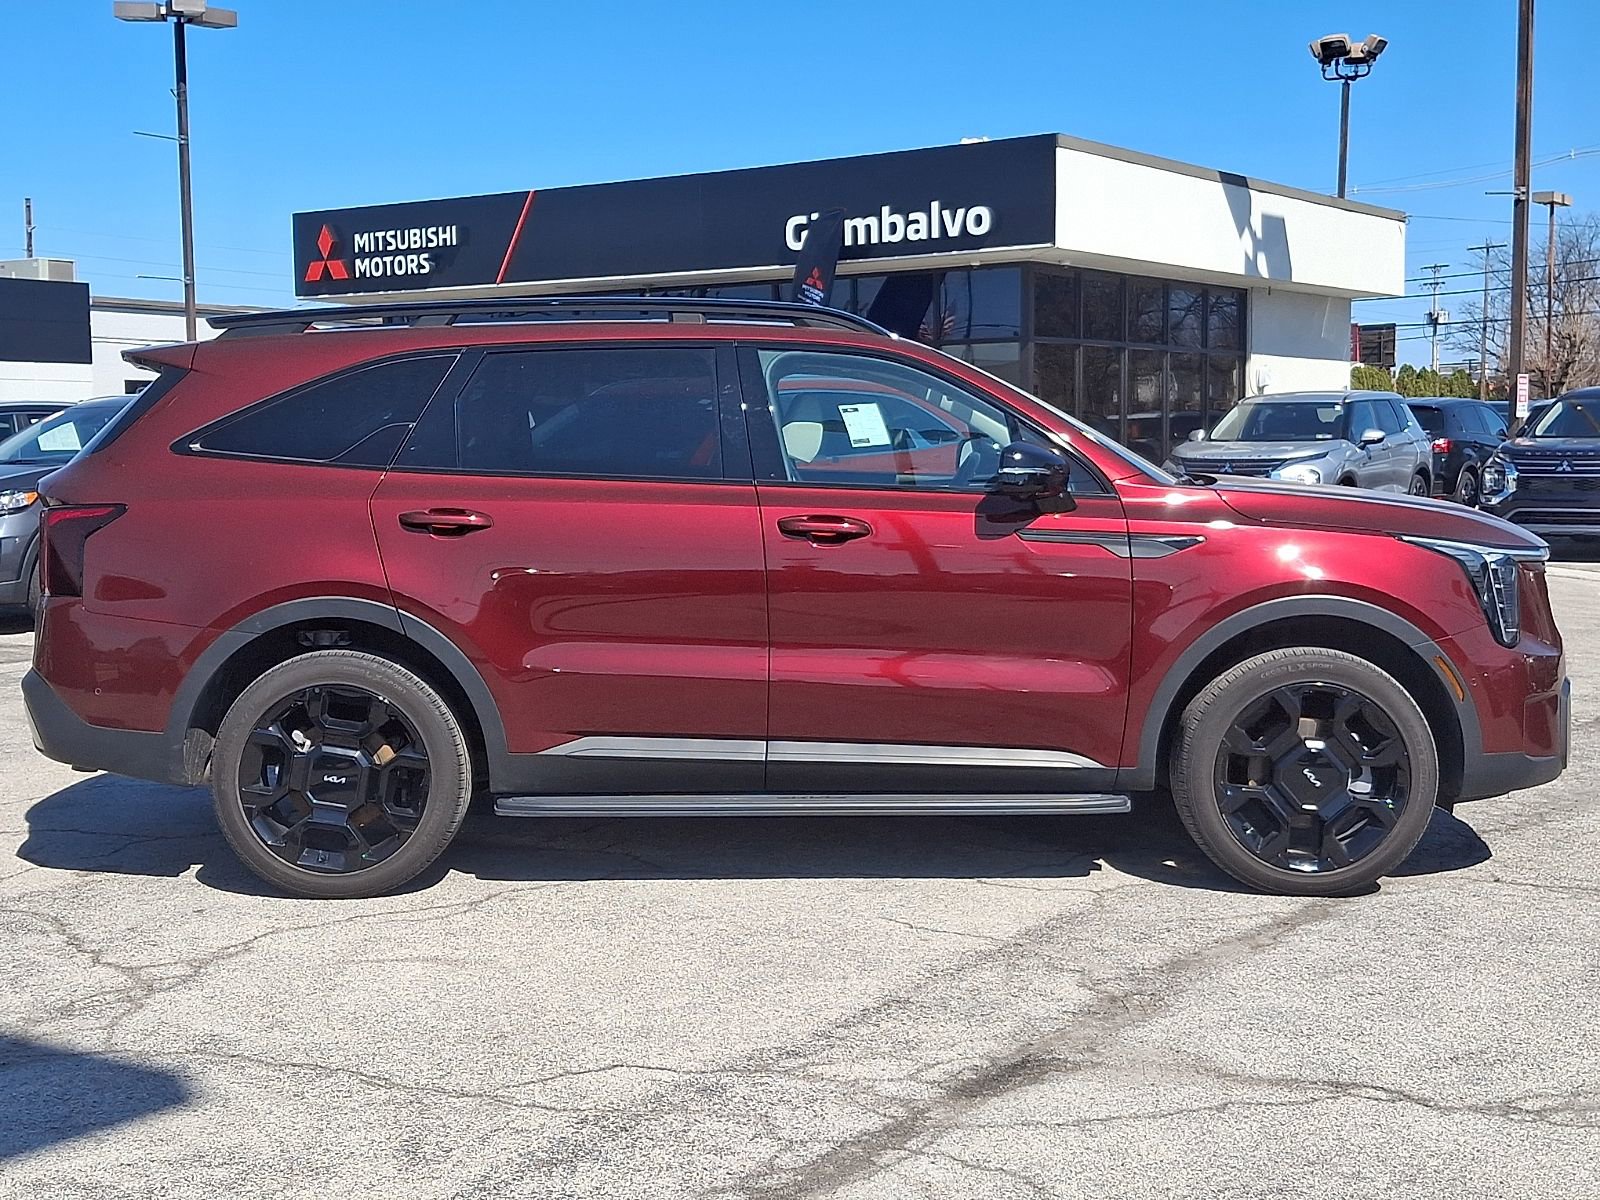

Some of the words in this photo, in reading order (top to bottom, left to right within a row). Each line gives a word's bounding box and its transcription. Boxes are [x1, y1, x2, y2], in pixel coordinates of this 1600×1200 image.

[353, 224, 458, 254] MITSUBISHI
[784, 200, 992, 251] Gmbalvo
[354, 253, 431, 279] MOTORS
